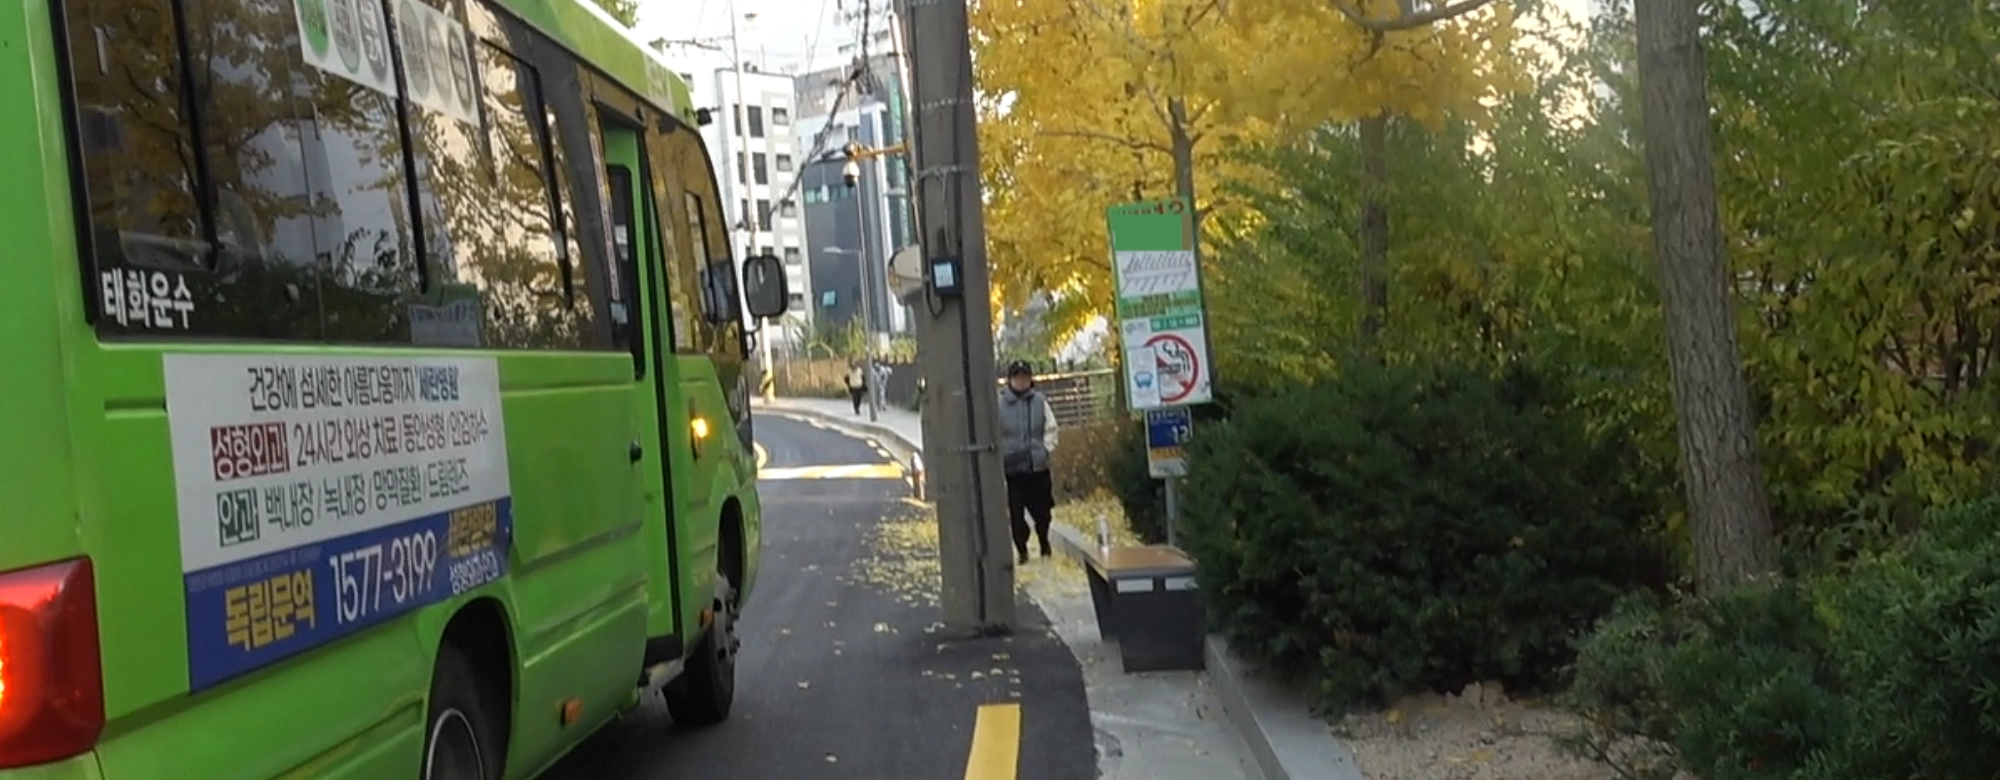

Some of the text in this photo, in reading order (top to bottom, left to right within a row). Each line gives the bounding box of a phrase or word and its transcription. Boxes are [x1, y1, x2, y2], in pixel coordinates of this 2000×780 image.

[102, 267, 194, 329] 태화운수
[248, 365, 298, 411] 건강에
[300, 364, 342, 407] 섬세한
[344, 364, 416, 406] 아름다움까지
[212, 423, 289, 481] 성형외과
[294, 418, 343, 467] 24시간
[345, 417, 371, 459] 외상
[217, 490, 259, 547] 안과
[264, 483, 314, 531] 백내장
[324, 472, 366, 519] 녹내장
[225, 567, 315, 651] 독립문역
[329, 529, 437, 624] 1577-3199
